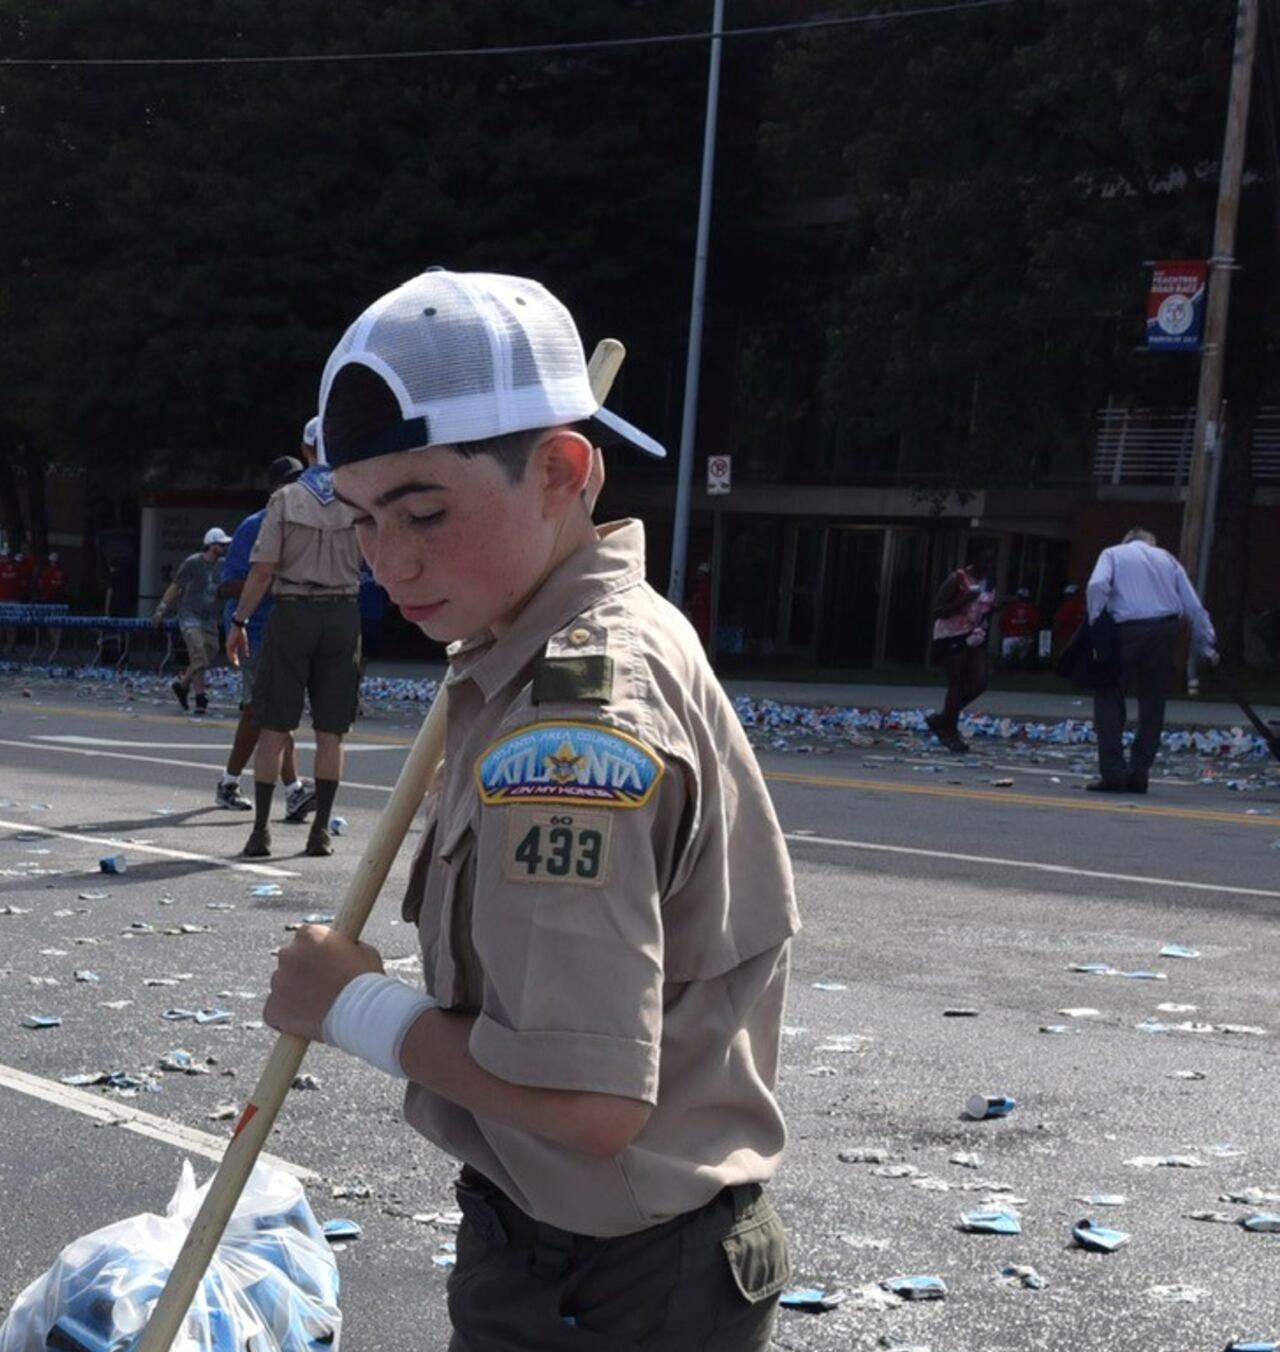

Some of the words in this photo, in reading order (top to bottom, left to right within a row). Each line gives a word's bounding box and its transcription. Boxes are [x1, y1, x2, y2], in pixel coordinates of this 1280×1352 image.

[534, 786, 555, 794] MY
[550, 815, 573, 825] 60
[515, 825, 602, 879] 433
